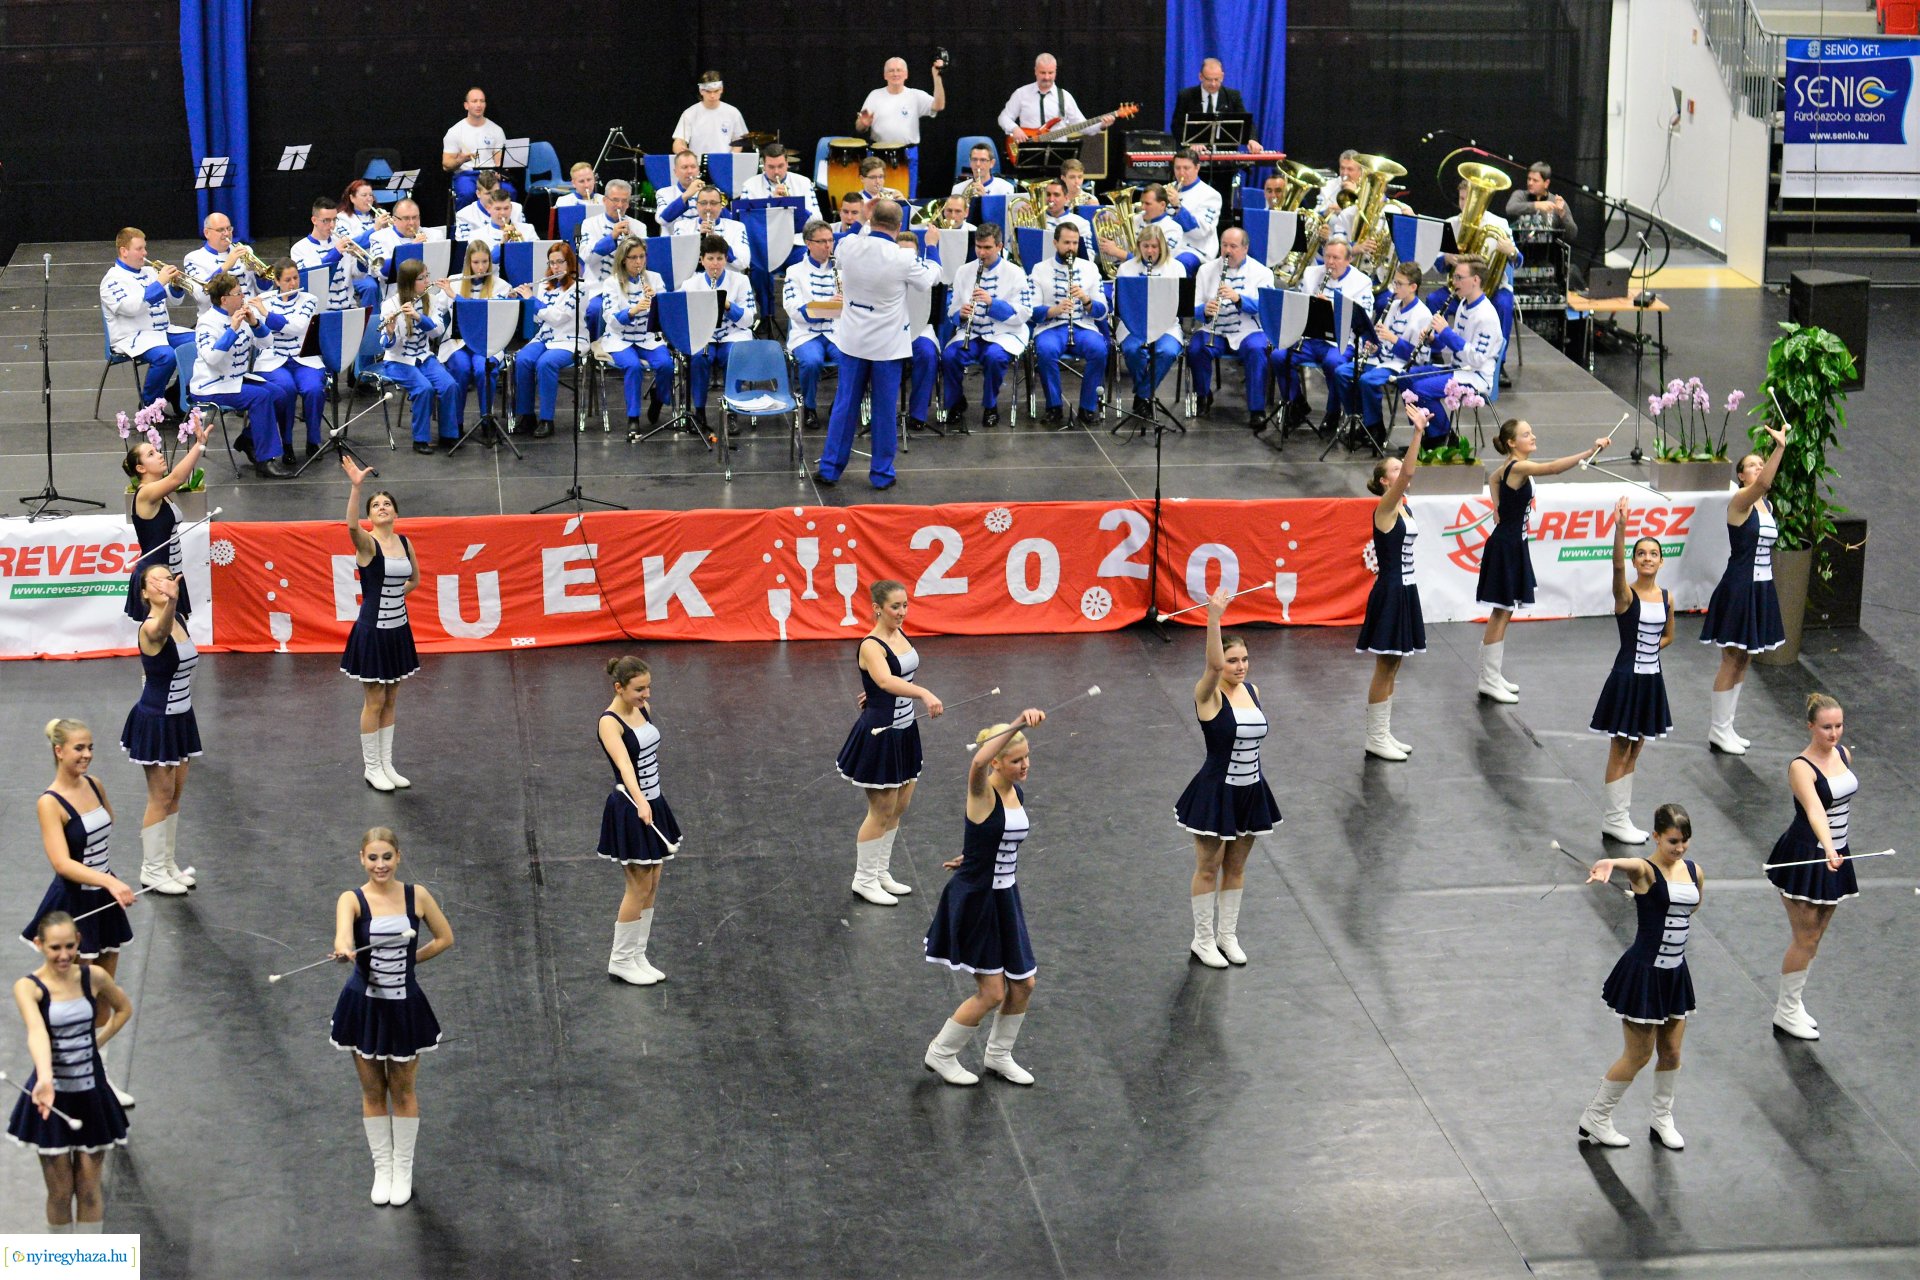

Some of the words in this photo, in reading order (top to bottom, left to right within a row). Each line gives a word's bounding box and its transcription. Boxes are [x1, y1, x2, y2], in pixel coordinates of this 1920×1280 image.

[1825, 44, 1859, 56] SENIO
[1862, 44, 1881, 56] KFT.
[1794, 75, 1886, 108] SENIO
[1854, 111, 1886, 122] szalon
[1809, 131, 1869, 141] www.senio.hu
[1536, 506, 1696, 541] REVESZ
[909, 508, 1240, 606] 2020
